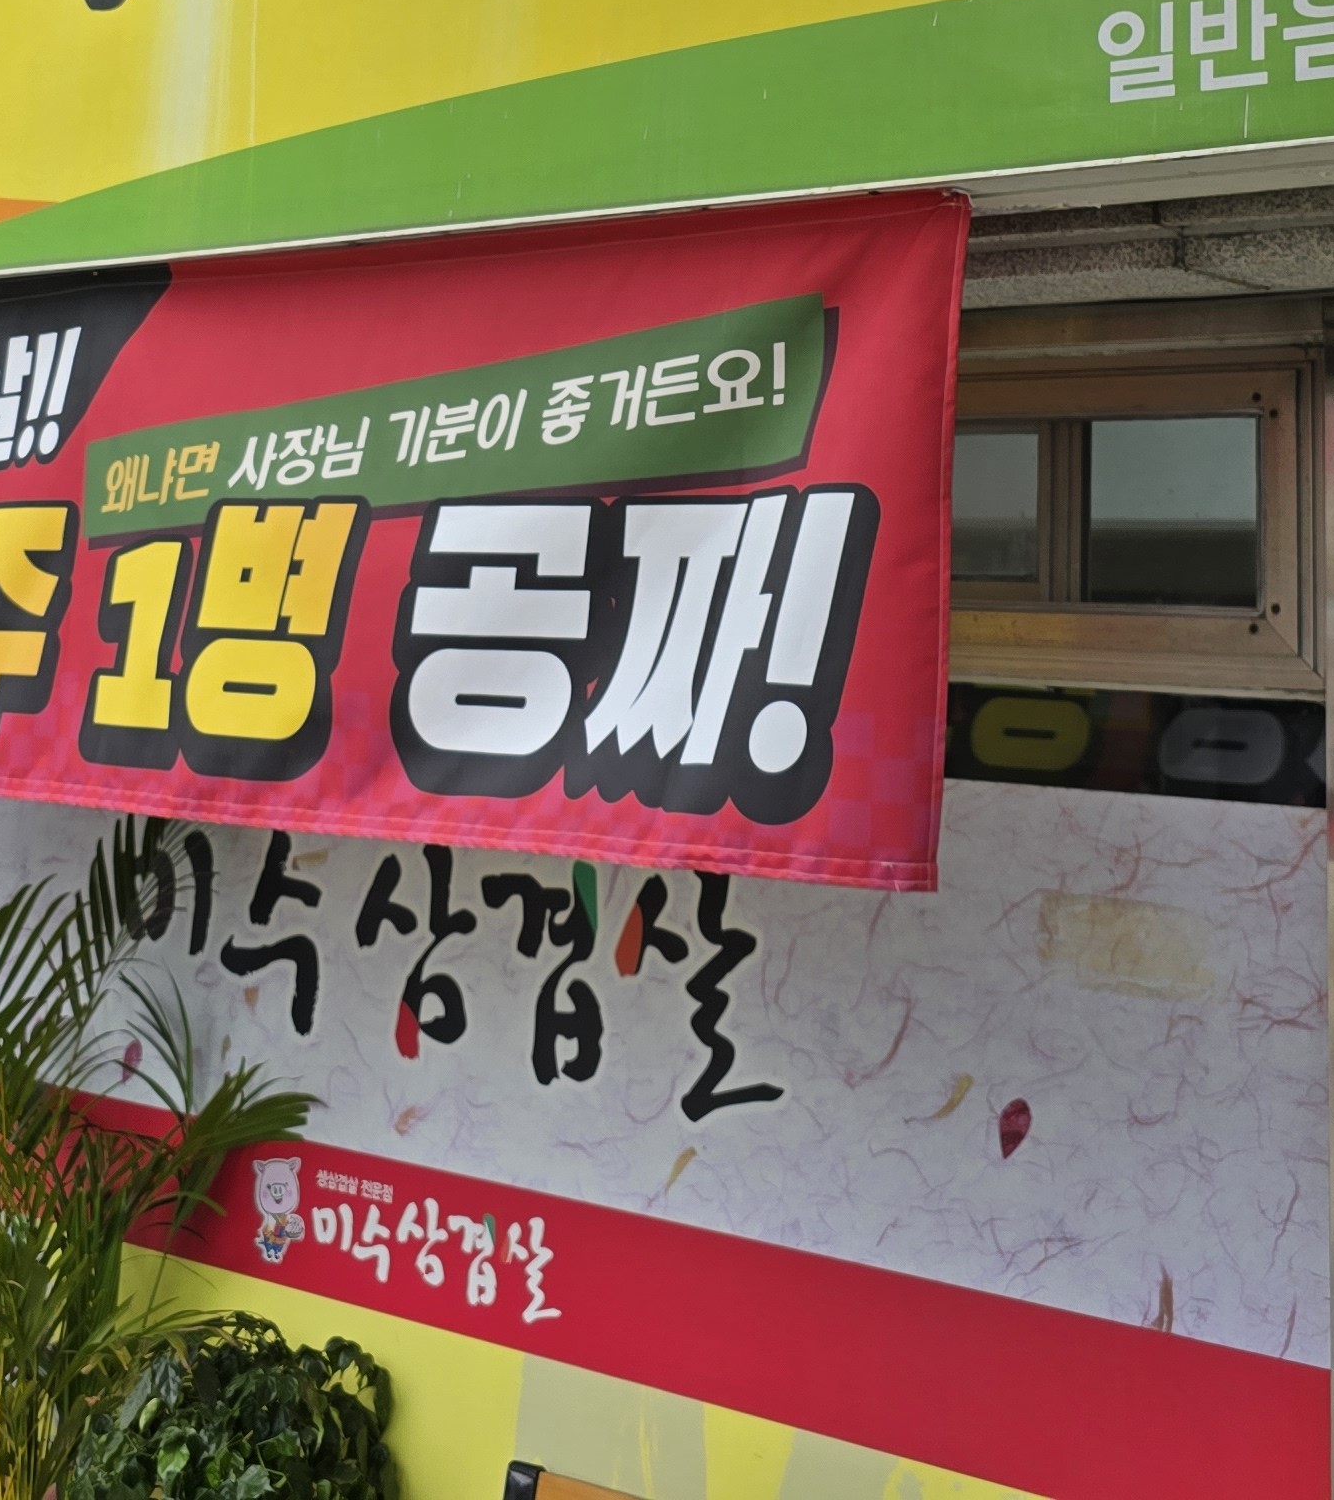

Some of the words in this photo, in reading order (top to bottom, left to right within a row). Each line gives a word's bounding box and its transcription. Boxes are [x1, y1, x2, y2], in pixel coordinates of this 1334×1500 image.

[102, 439, 221, 515] 왜냐면
[226, 414, 369, 494] 사장님
[387, 386, 526, 468] 기분이
[92, 504, 359, 743] 1병
[407, 491, 856, 776] 공짜!
[312, 1197, 562, 1324] 미수삼겹살
